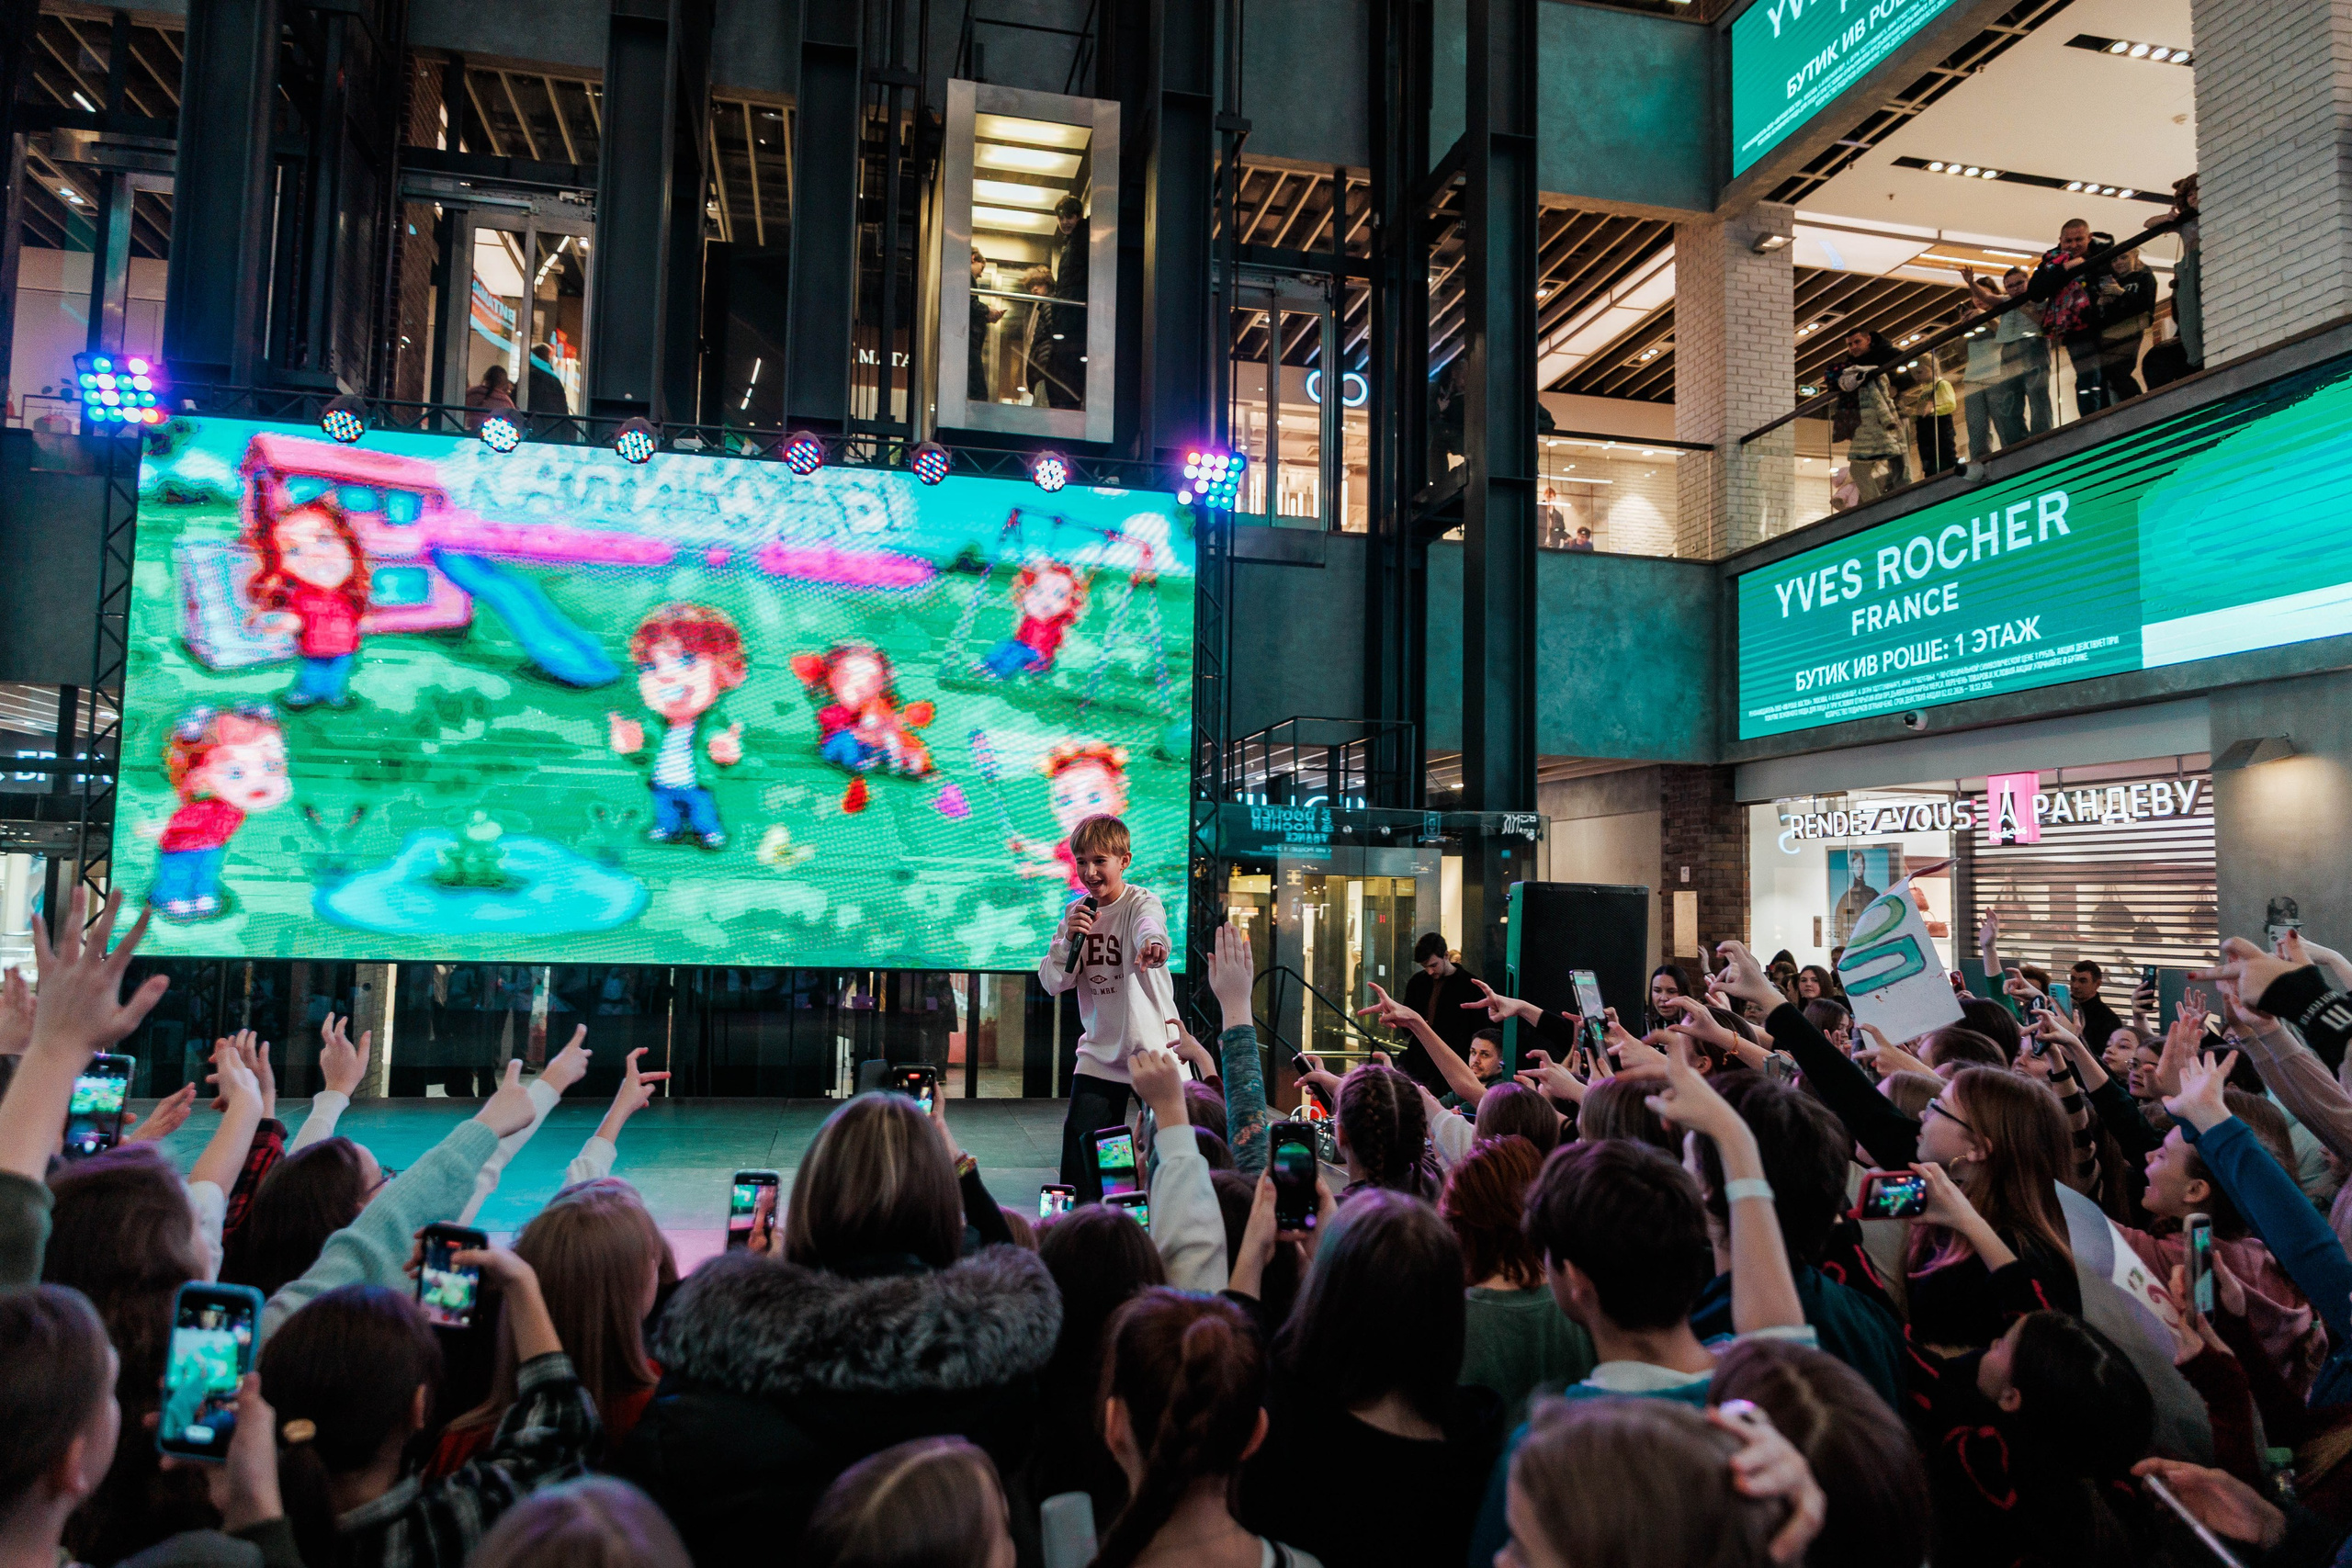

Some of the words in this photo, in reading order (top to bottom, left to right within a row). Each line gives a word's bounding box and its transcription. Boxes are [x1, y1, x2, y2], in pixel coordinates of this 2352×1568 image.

[1768, 0, 1819, 39] YV
[1787, 39, 1839, 99] БУТИК
[1842, 17, 1866, 53] ИВ
[1870, 0, 1905, 29] РО
[1775, 558, 1862, 618] YVES
[1877, 490, 2071, 590] ROCHER
[1851, 581, 1959, 637] FRANCE
[1795, 660, 1849, 692] БУТИК
[1853, 653, 1879, 679] ИВ
[1883, 641, 1949, 672] РОШЕ:
[1954, 634, 1964, 656] 1
[1972, 615, 2041, 653] ЭТАЖ
[1791, 800, 1972, 840] RENDEZ-VOUS
[2032, 779, 2199, 825] РАНДЕВУ
